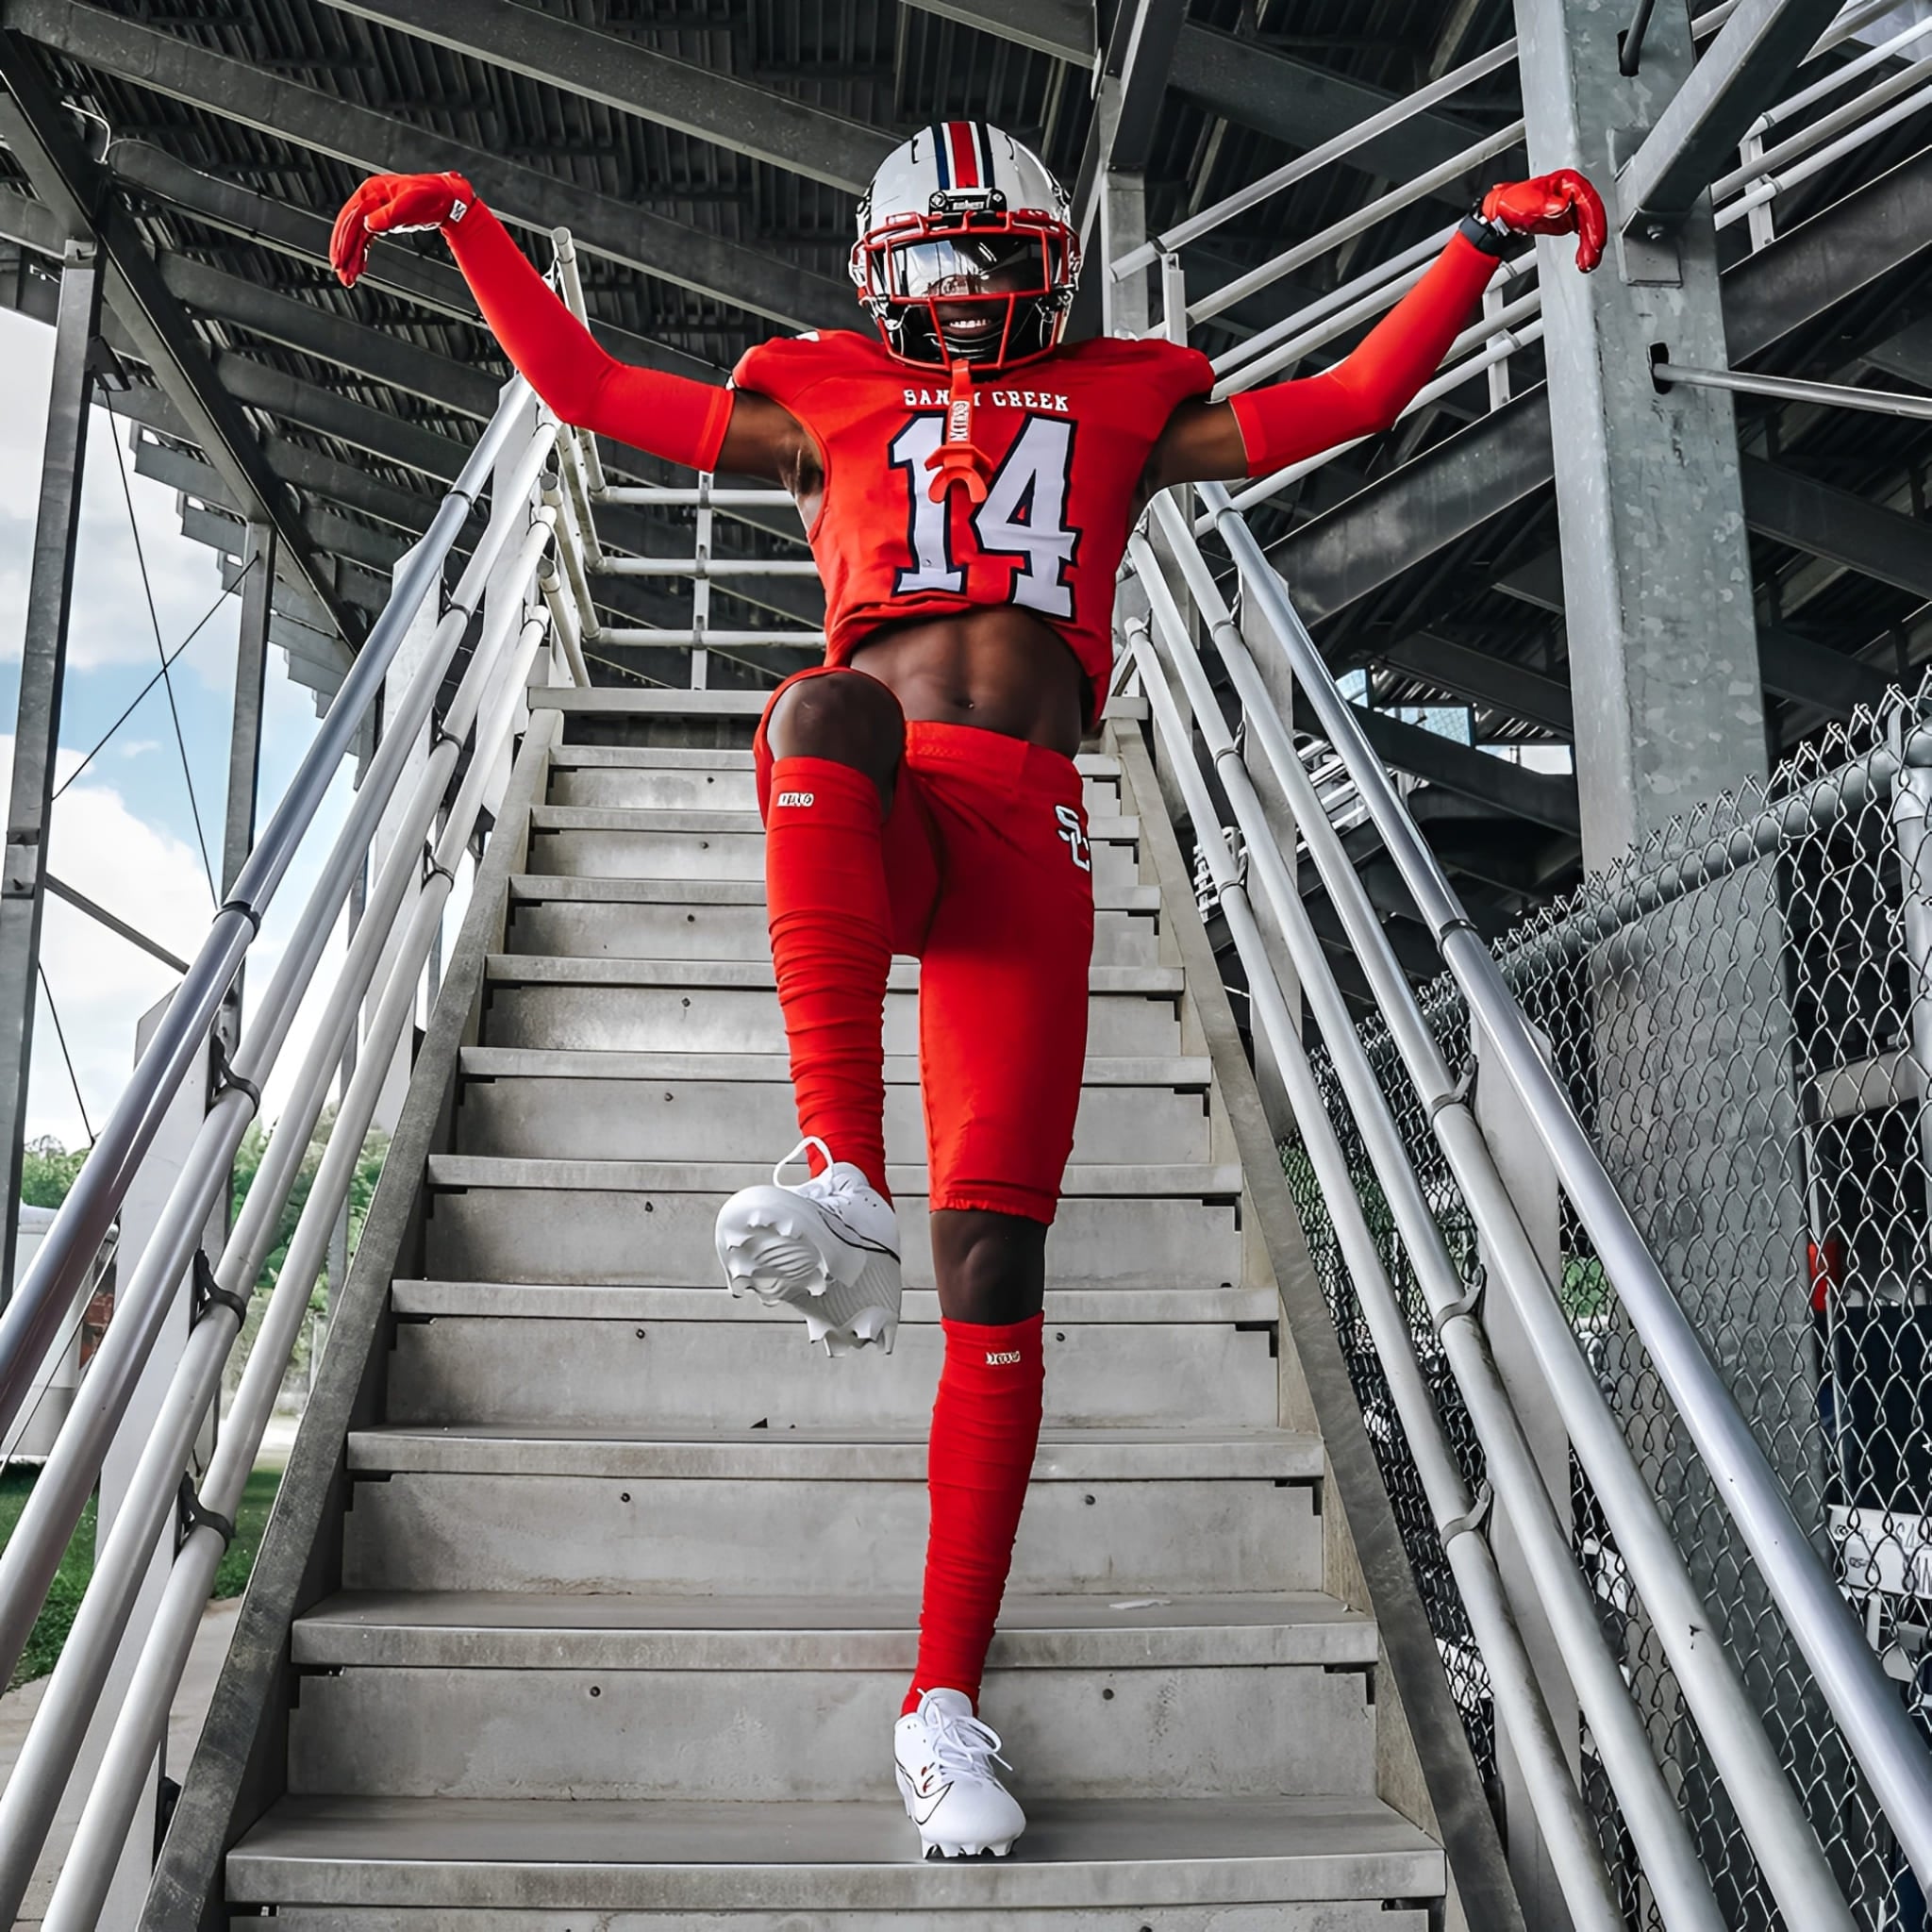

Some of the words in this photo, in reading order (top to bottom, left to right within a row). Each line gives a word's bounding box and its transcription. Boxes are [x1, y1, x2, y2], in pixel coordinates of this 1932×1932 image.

[903, 389, 981, 407] SANY
[992, 391, 1070, 412] CREEK
[888, 411, 1083, 623] 14
